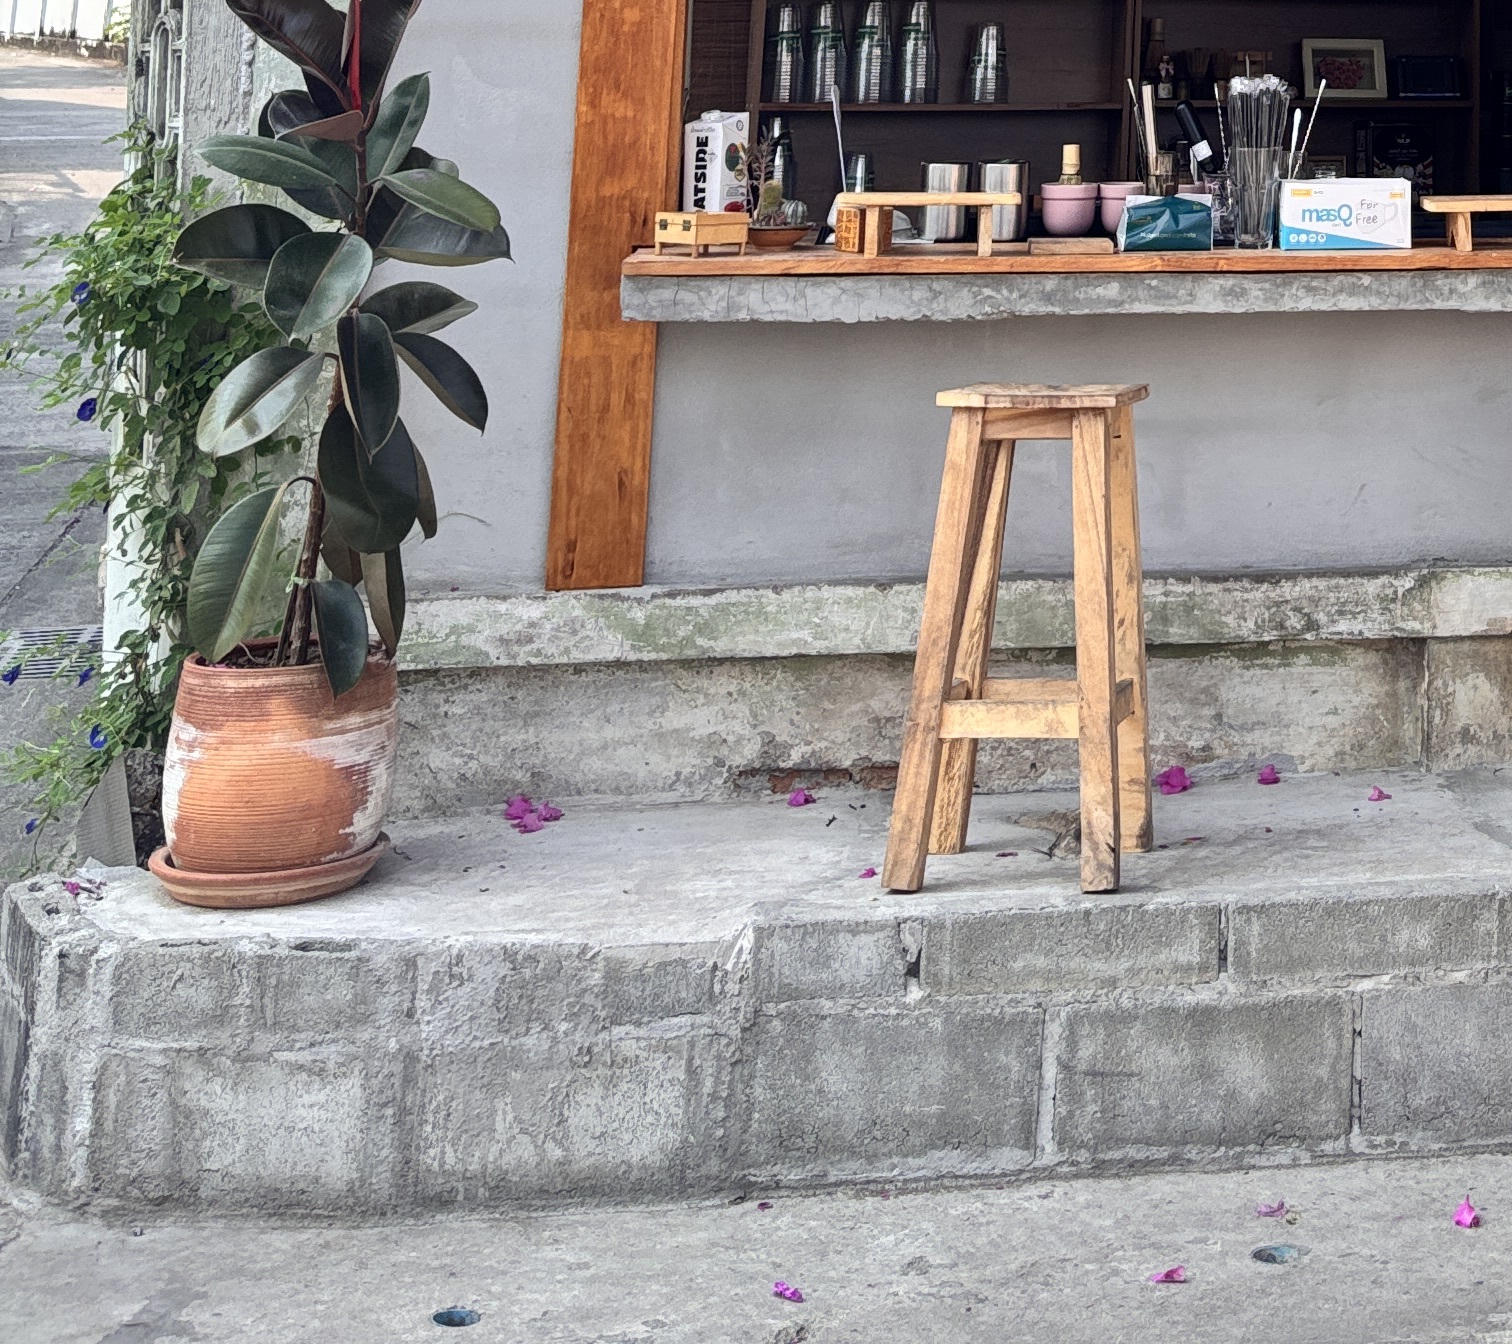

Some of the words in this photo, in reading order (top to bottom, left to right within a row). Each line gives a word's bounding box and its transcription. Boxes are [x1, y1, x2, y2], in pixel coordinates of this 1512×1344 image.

[693, 135, 709, 211] ATSIDE
[1361, 199, 1379, 210] For
[1302, 204, 1353, 227] masQ
[1356, 213, 1378, 225] Free
